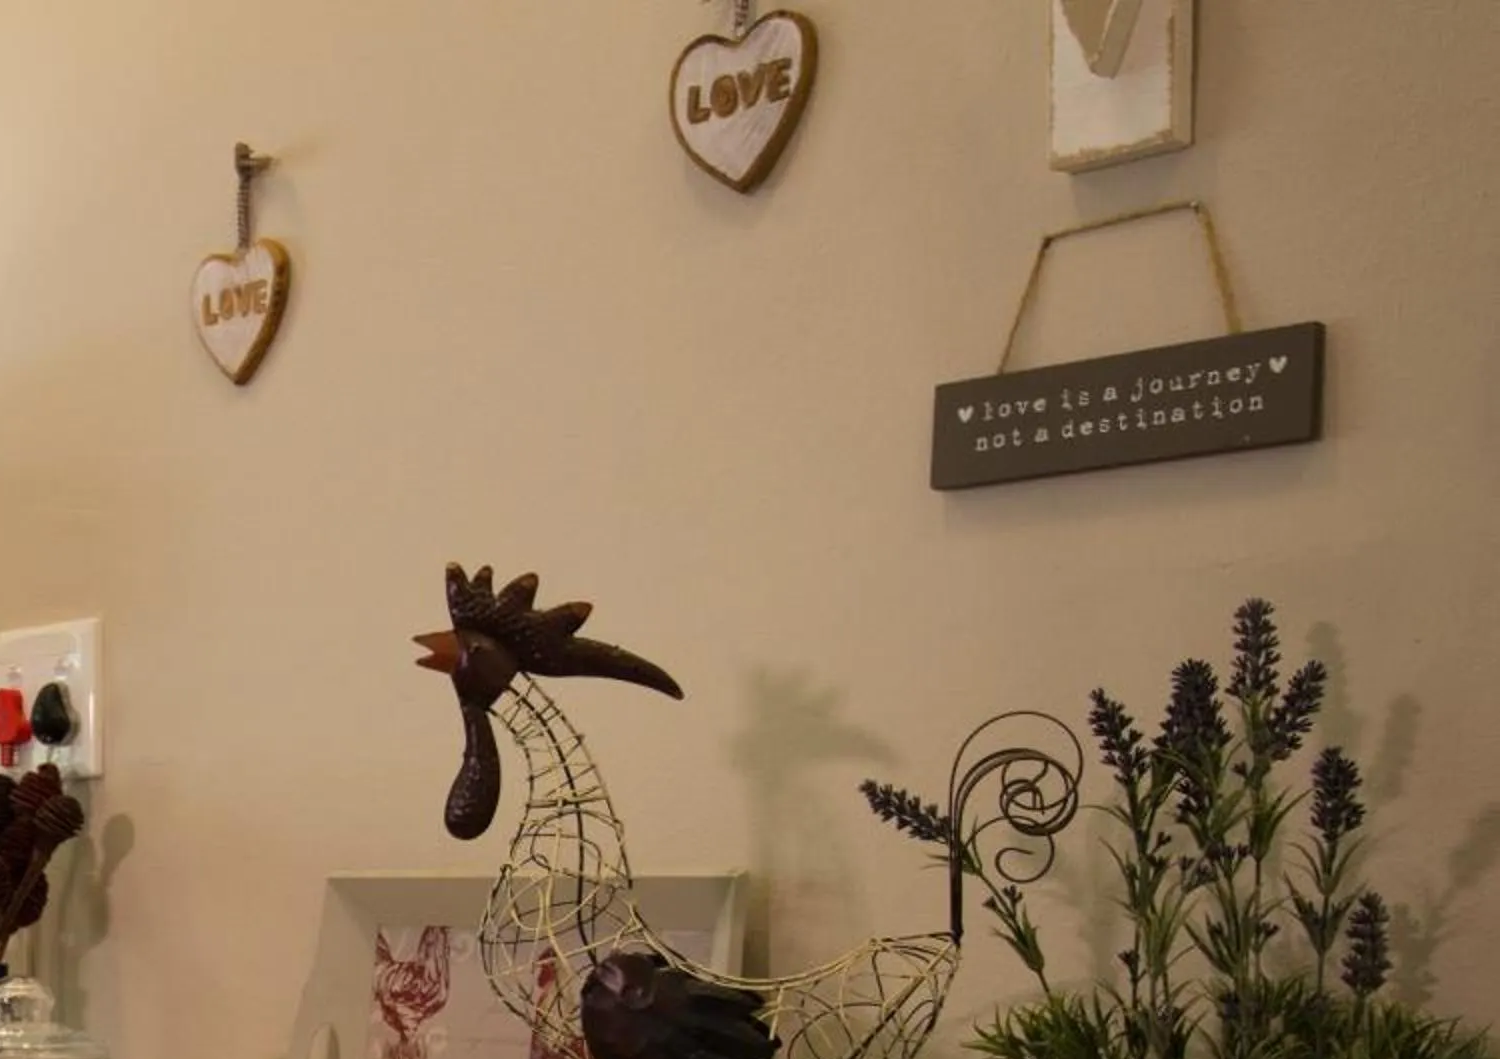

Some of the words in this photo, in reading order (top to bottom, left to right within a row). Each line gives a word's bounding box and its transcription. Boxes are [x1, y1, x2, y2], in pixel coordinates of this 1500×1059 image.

[686, 57, 793, 125] LOVE
[201, 278, 269, 326] LOVE
[982, 398, 1047, 421] love
[1061, 388, 1091, 410] is
[1103, 386, 1118, 402] a
[1130, 362, 1262, 402] journey
[975, 428, 1024, 451] not
[1034, 427, 1049, 443] a
[1061, 395, 1264, 439] destination
